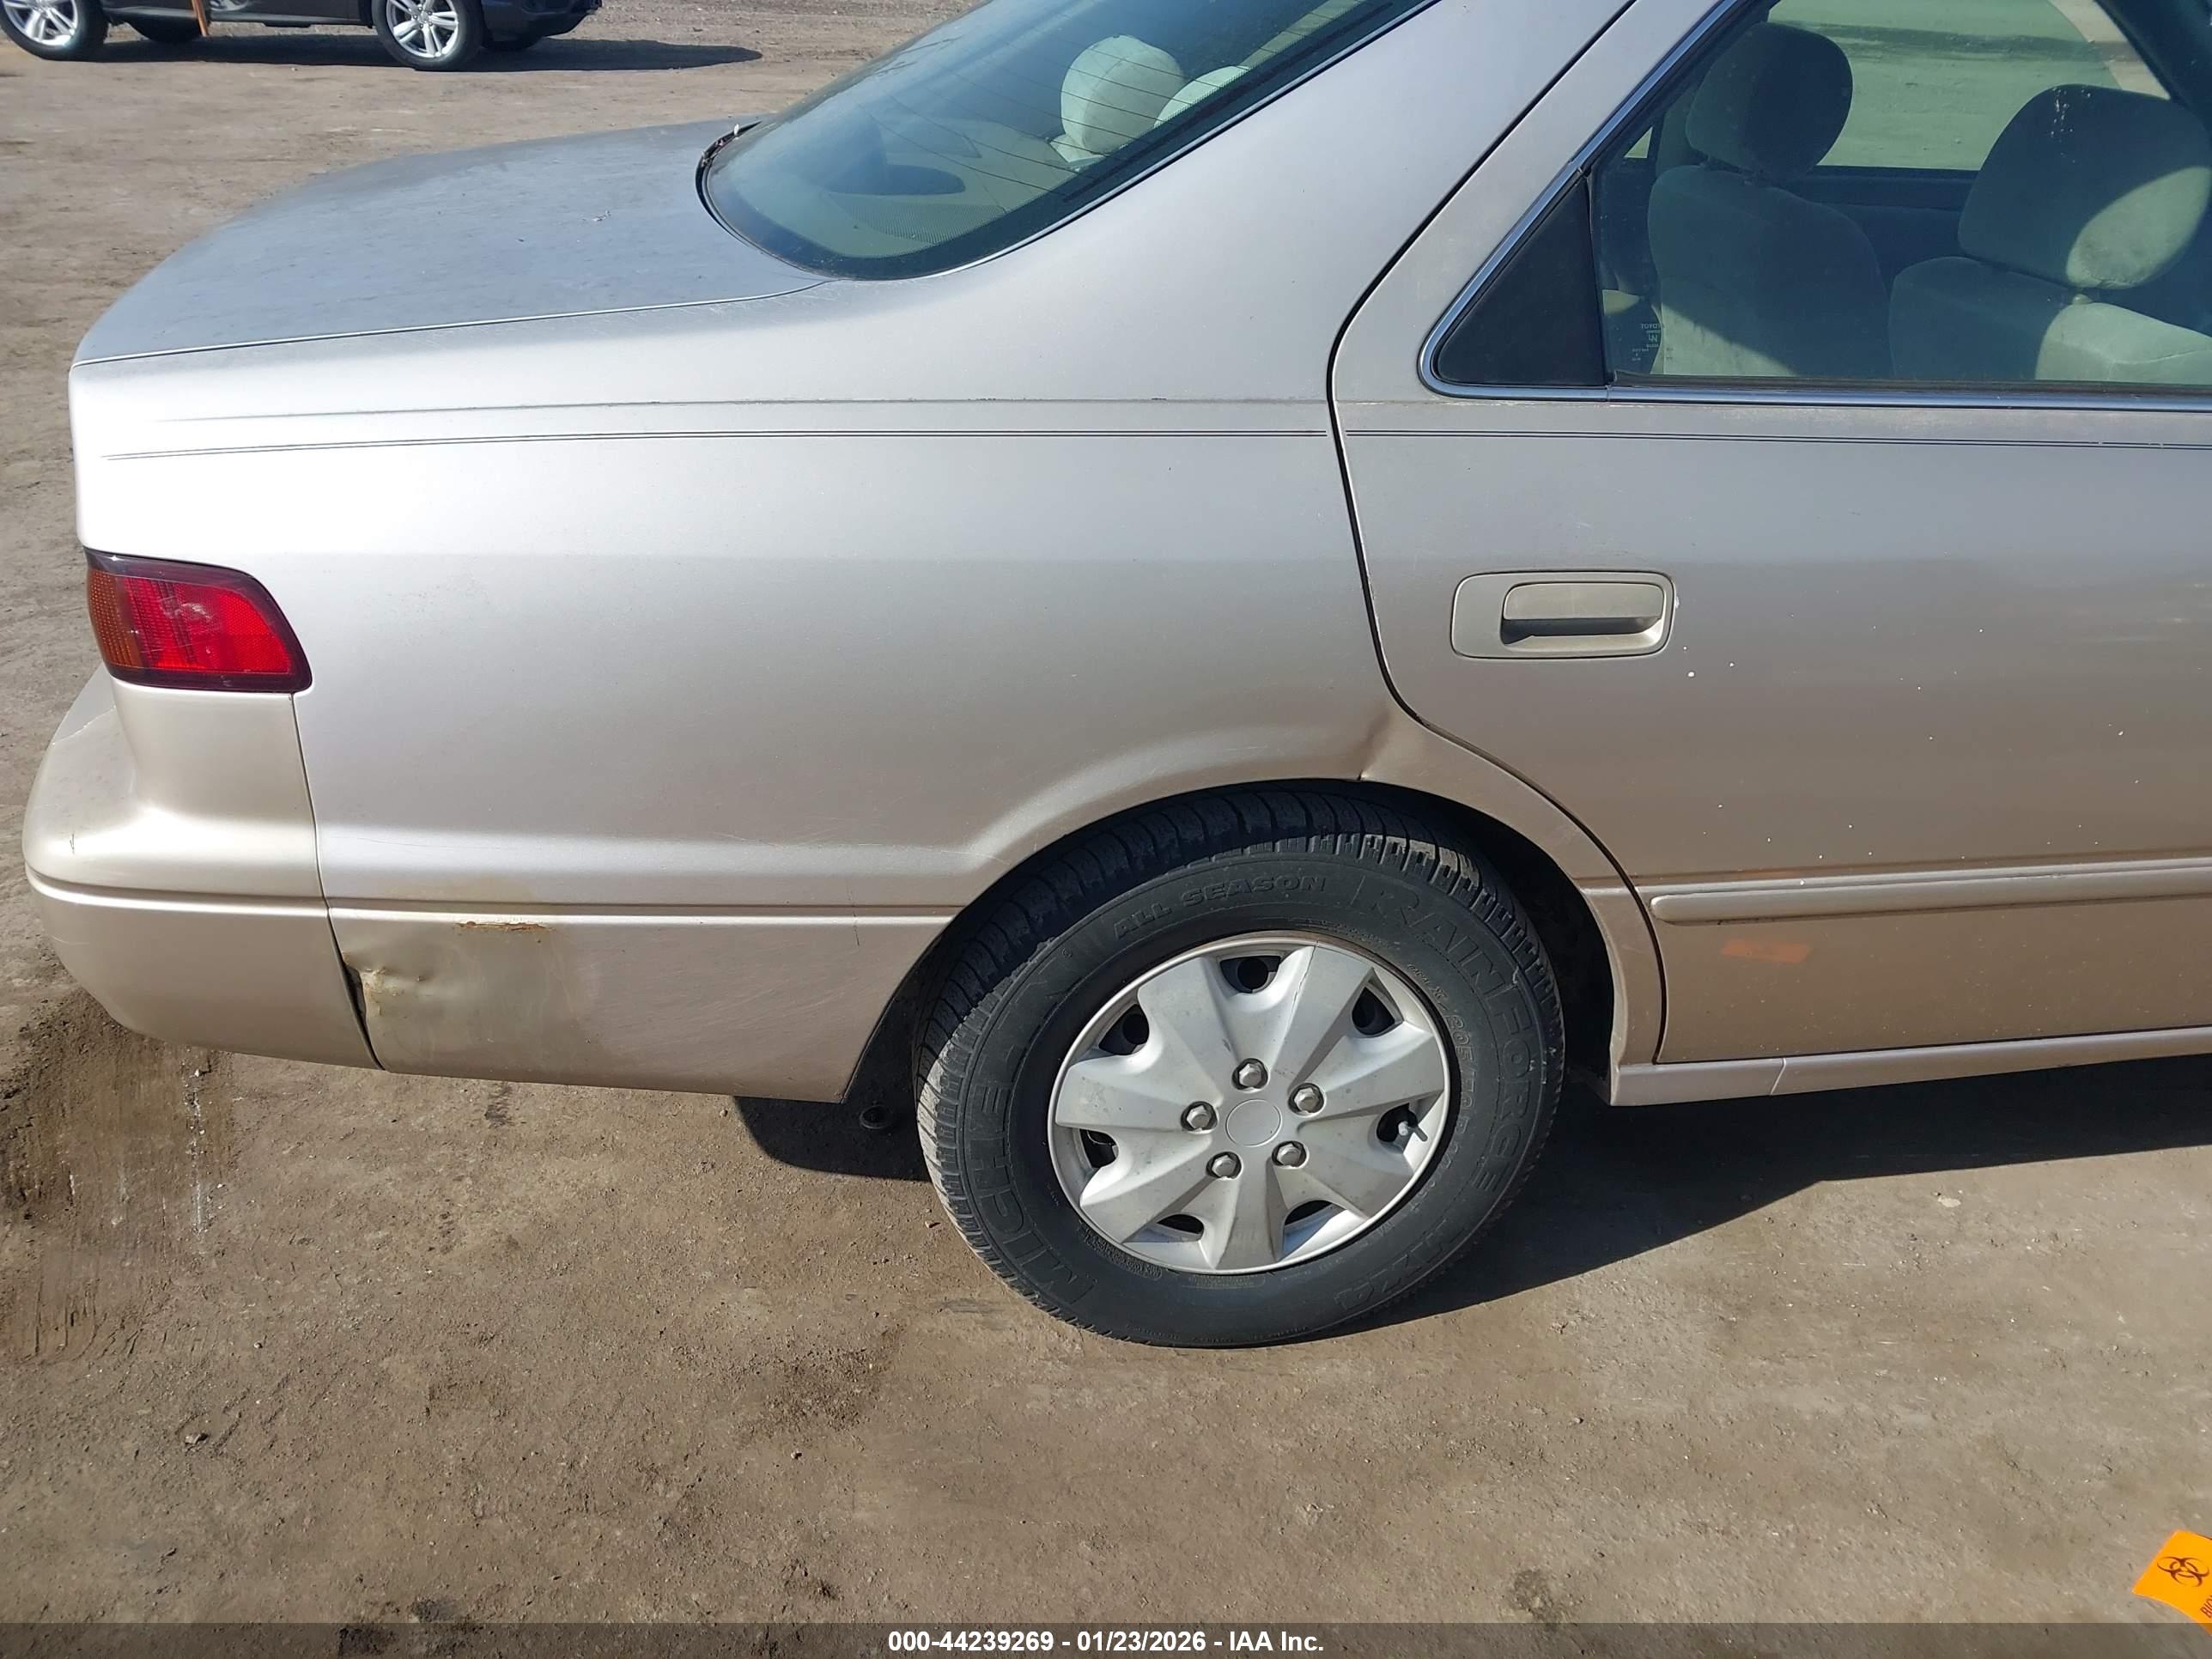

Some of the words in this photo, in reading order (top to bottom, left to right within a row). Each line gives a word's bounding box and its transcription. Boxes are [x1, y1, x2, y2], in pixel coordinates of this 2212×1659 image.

[1113, 902, 1172, 939] ALL
[1180, 874, 1327, 908] SEASON
[968, 955, 1095, 1306] MICHELIN
